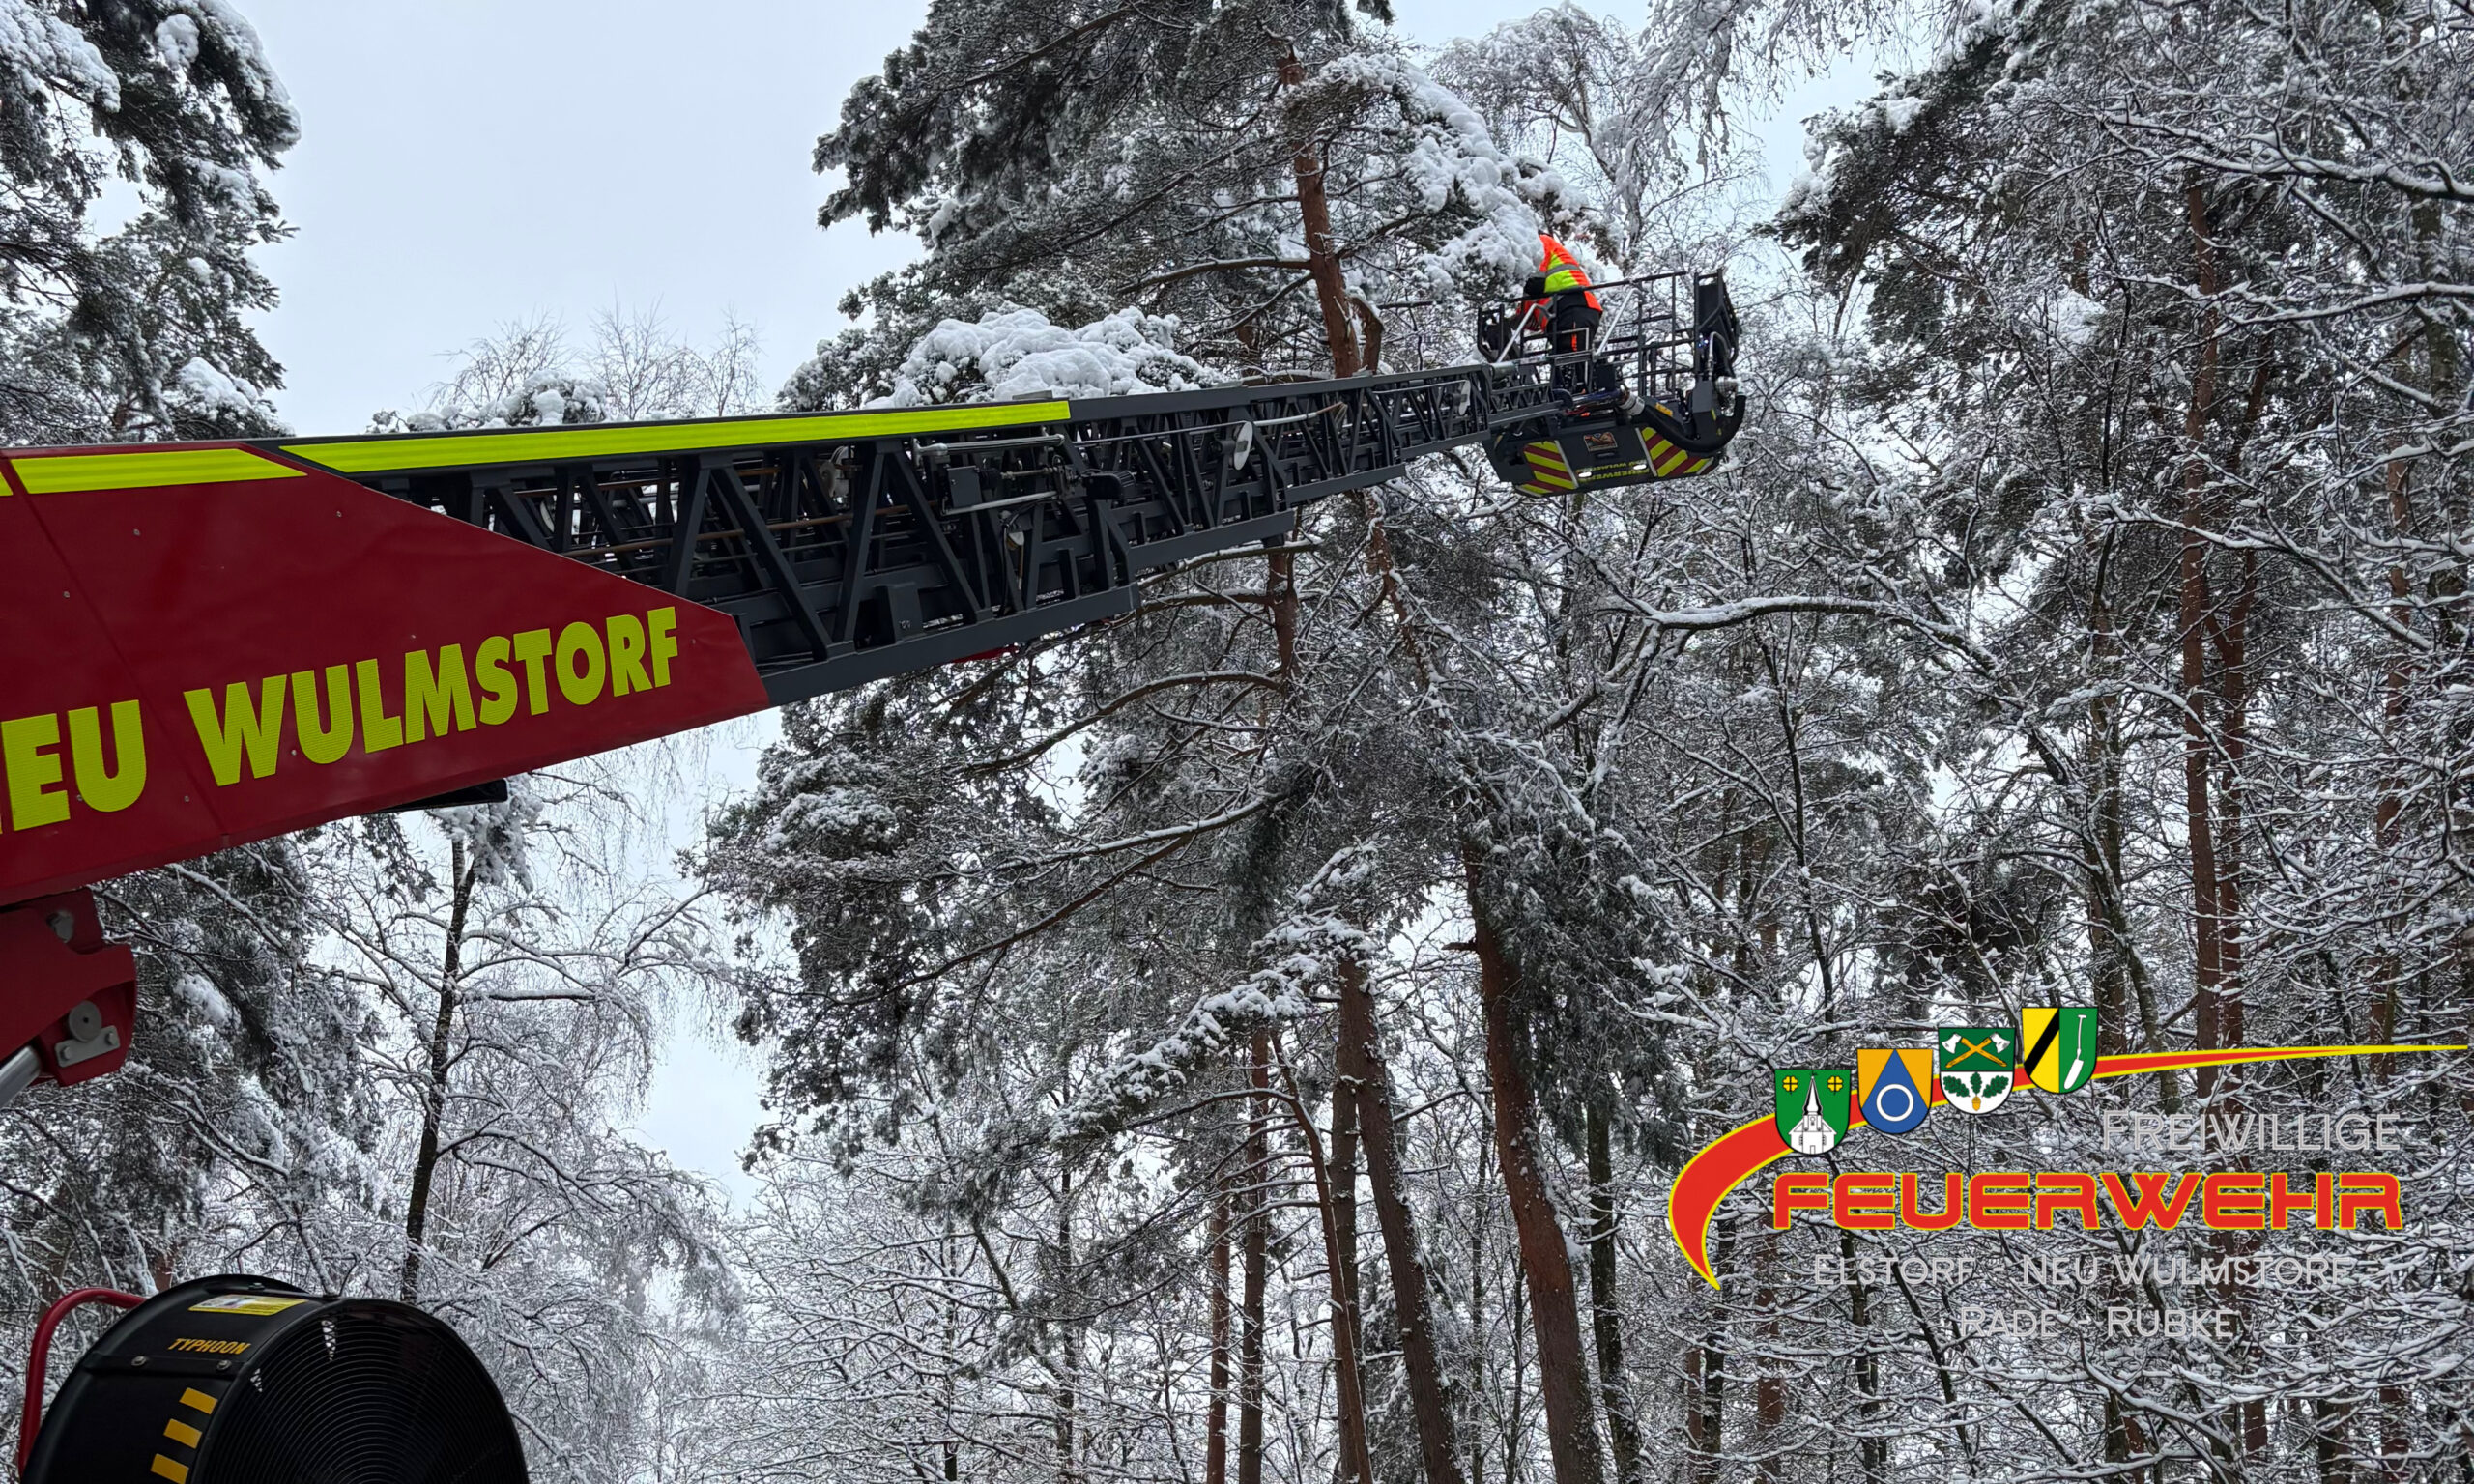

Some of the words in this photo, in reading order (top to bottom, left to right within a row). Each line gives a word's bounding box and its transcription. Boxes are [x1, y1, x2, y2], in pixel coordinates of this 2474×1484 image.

[0, 699, 147, 834] EU
[184, 606, 678, 786] WULMSTORF
[168, 1337, 251, 1355] TYPHOON
